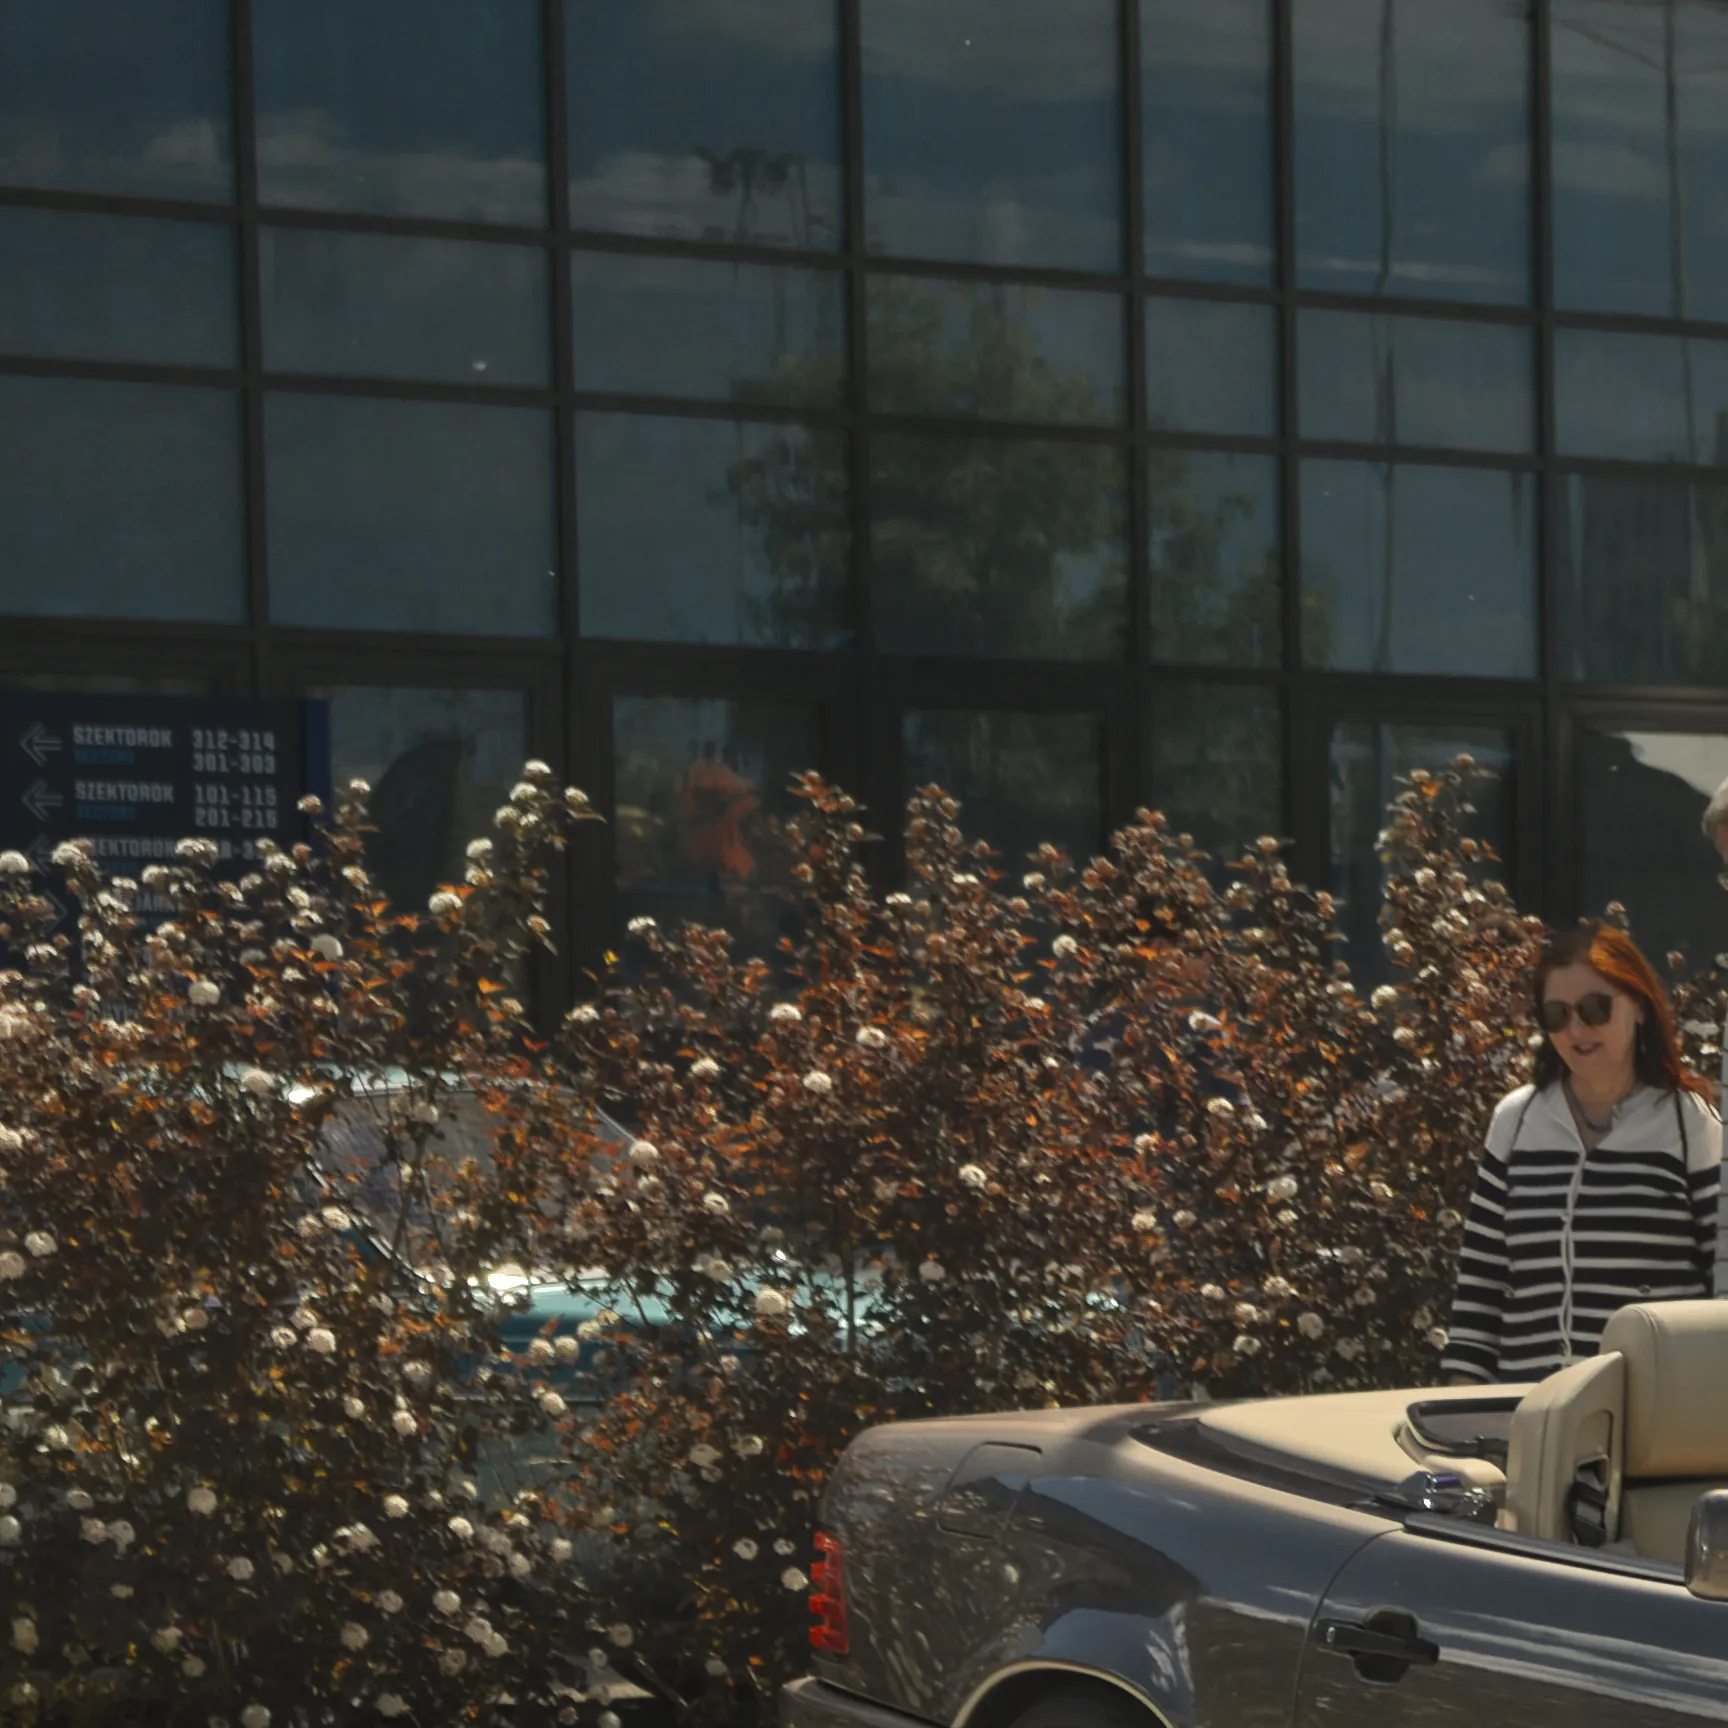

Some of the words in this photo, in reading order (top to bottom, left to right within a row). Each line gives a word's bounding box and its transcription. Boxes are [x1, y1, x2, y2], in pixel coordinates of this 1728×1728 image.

[72, 724, 173, 748] SZEKTOROK
[192, 729, 275, 751] 312-314
[193, 752, 276, 774] 301-303
[75, 780, 174, 803] SZEKTOROK
[195, 784, 277, 807] 101-115
[194, 808, 278, 829] 201-215
